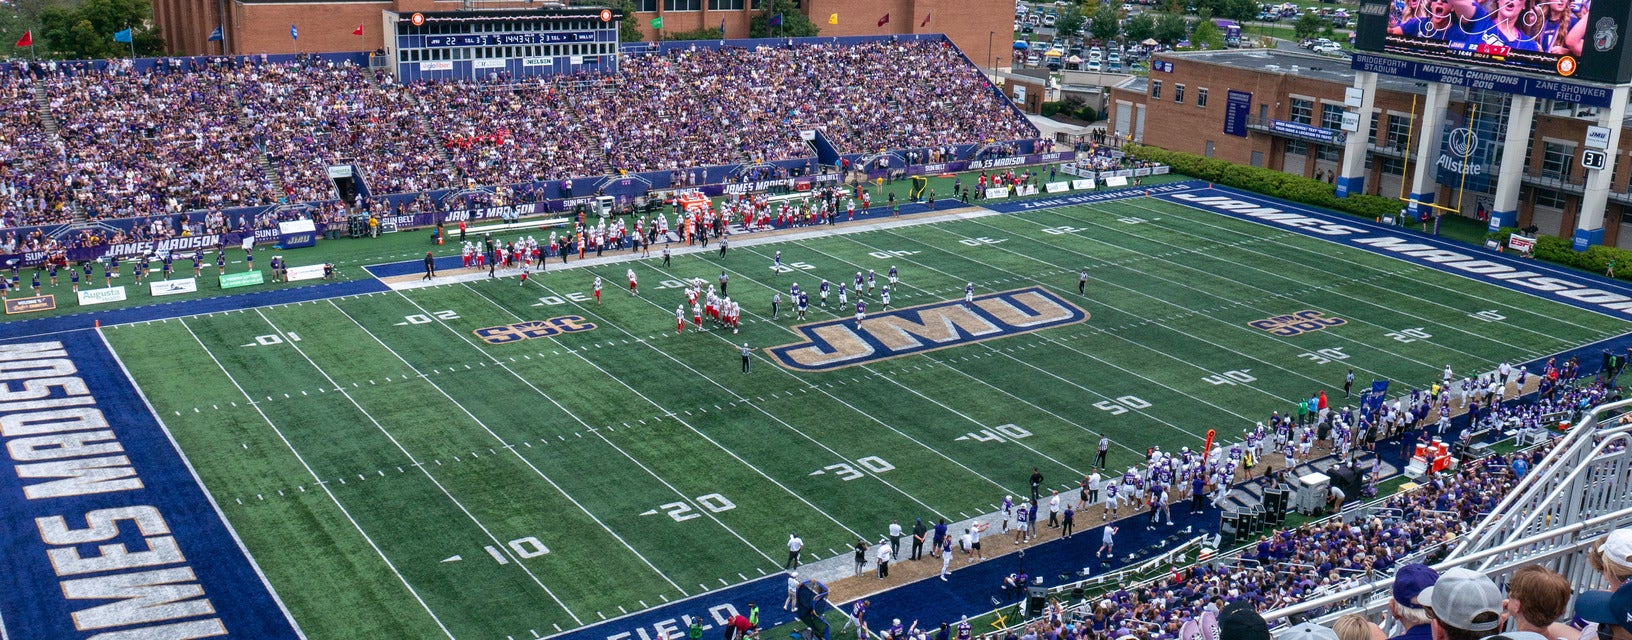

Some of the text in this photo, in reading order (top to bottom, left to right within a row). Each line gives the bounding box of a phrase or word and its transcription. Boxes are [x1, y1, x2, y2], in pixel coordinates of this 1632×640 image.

[446, 37, 456, 45] 22
[1357, 55, 1407, 68] BRIDGEFORTH
[1364, 63, 1398, 75] STADIUM
[1422, 64, 1518, 85] NATIONAL CHAMPIONS
[1440, 75, 1494, 90] 2004 2016
[1536, 81, 1606, 98] ZANE SHOWKER
[1556, 91, 1582, 102] FIELD
[994, 156, 1026, 167] MADISON
[1435, 154, 1481, 175] Allstate
[1586, 153, 1602, 166] 31
[723, 182, 753, 194] JAMES
[1019, 183, 1191, 209] ZANE SHOWKER FIELD
[382, 217, 398, 225] SUN
[398, 215, 414, 224] BELT
[445, 210, 484, 222] JAMS
[1170, 193, 1370, 236] JAMES
[255, 229, 272, 238] SUN
[105, 234, 220, 256] JAMES MADISON
[25, 252, 44, 261] SUN
[83, 288, 120, 300] Augusta
[542, 292, 592, 306] 30
[405, 310, 460, 326] 20
[1467, 310, 1507, 322] 10
[472, 315, 598, 345] SBC
[775, 288, 1083, 369] JMU
[1385, 328, 1434, 344] 20
[254, 330, 302, 346] 10
[1298, 347, 1351, 364] 30
[1201, 370, 1258, 386] 40
[1092, 395, 1152, 416] 50
[967, 423, 1033, 443] 40
[823, 456, 896, 482] 30
[659, 492, 736, 522] 20
[484, 536, 550, 565] 10
